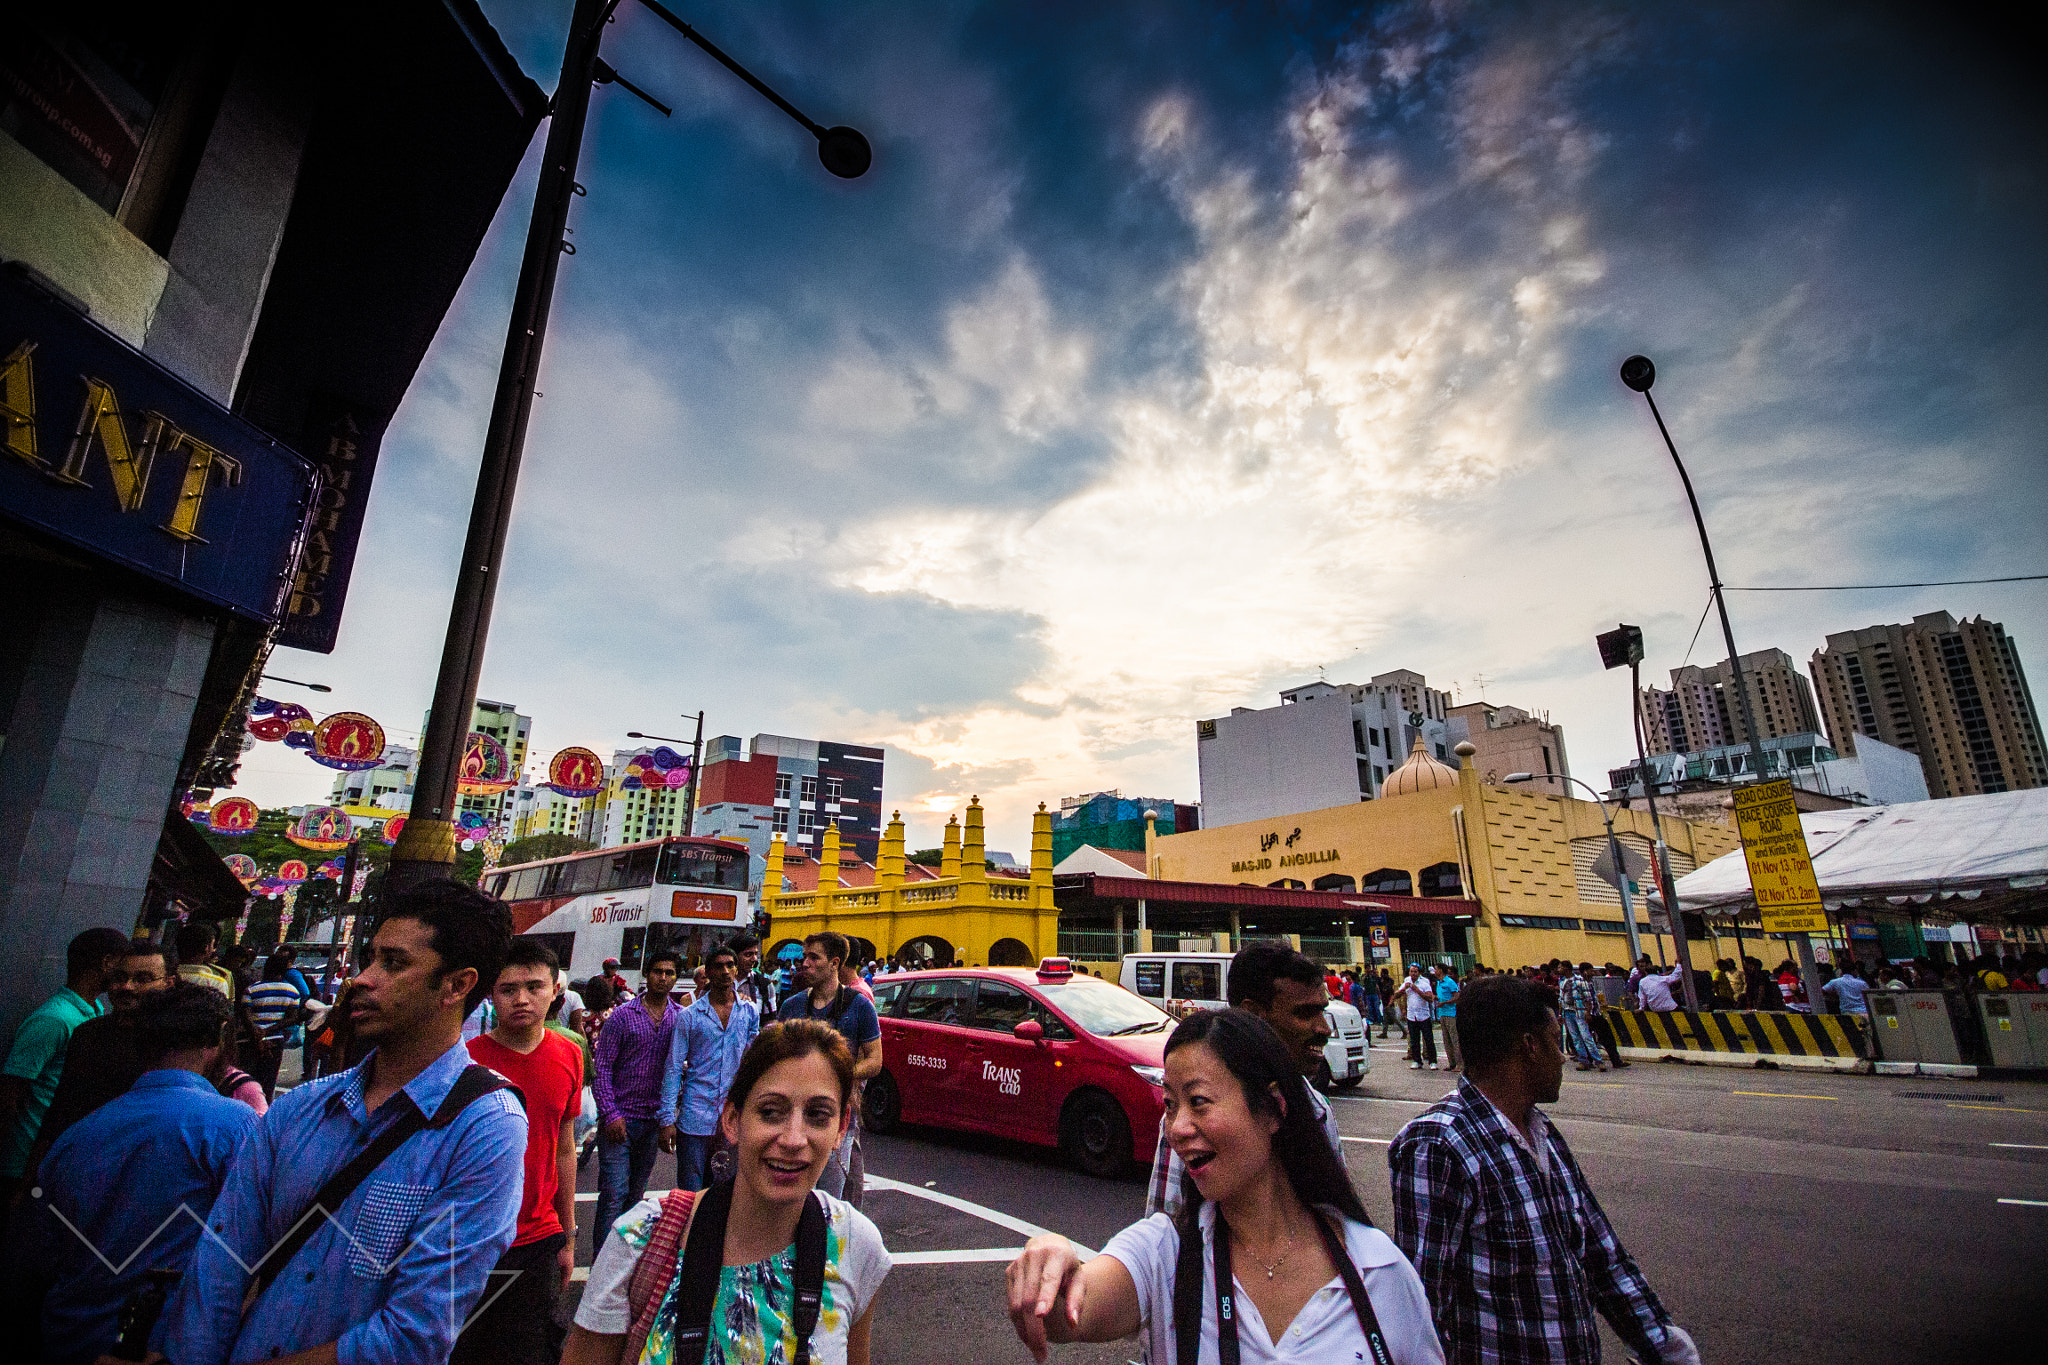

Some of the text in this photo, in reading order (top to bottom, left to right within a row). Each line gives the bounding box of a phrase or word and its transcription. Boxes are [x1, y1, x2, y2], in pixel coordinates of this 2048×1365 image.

[1734, 782, 1792, 805] ROAD CLOSURE
[1739, 801, 1795, 823] RACE COURSE
[1759, 819, 1783, 833] ROAD
[1759, 831, 1793, 846] Hampshire
[680, 849, 734, 863] SBS Transit
[1231, 849, 1341, 873] MASJID ANGULLIA
[1755, 847, 1768, 859] and
[1752, 862, 1762, 875] 01
[1763, 861, 1778, 874] Nov
[1792, 859, 1809, 875] 7pm
[1779, 875, 1788, 886] to
[1758, 889, 1768, 902] 02
[1768, 888, 1785, 901] Nov
[1800, 886, 1816, 900] 2am
[590, 901, 645, 925] SBS Transit
[695, 899, 712, 912] 23
[907, 1054, 947, 1070] 6555-3333
[999, 1081, 1021, 1096] cab
[1221, 1296, 1232, 1320] EOS
[1370, 1332, 1390, 1365] Cano
